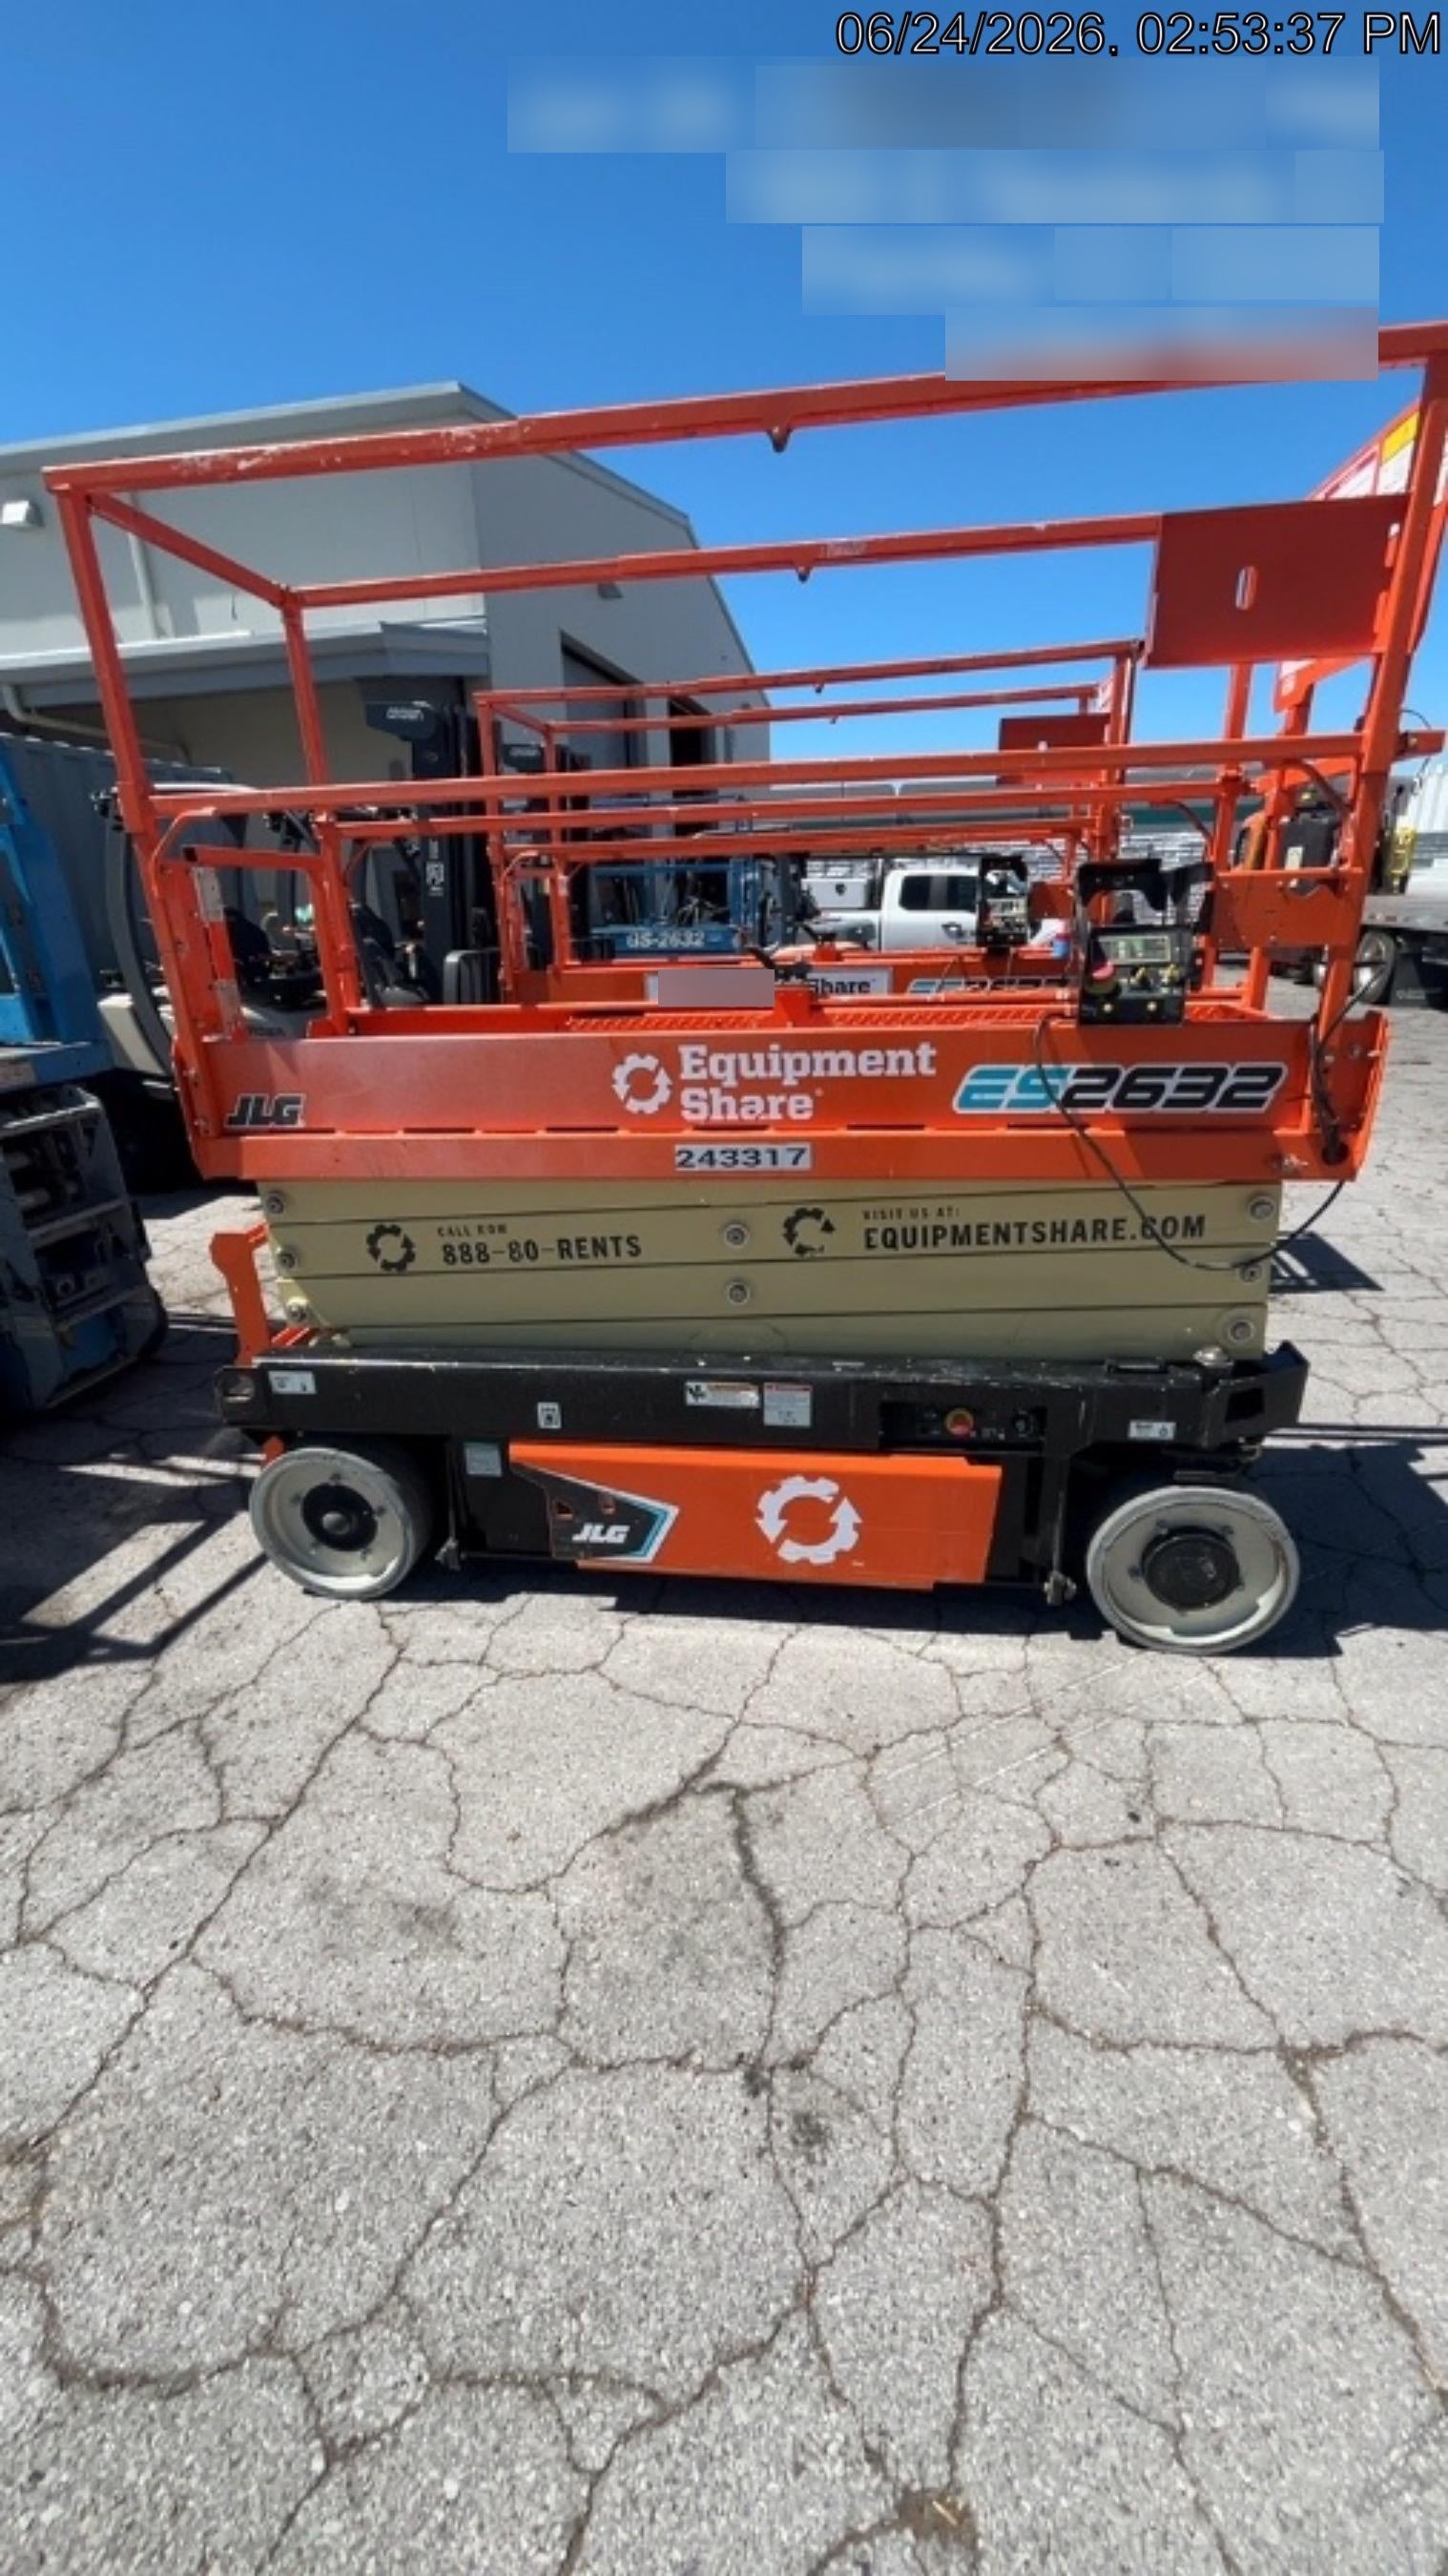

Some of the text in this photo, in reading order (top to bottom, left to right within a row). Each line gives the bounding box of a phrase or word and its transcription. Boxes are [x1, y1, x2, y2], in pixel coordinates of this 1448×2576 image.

[678, 1042, 937, 1086] Equipment
[680, 1088, 814, 1123] Share
[953, 1063, 1287, 1113] ES2632
[223, 1093, 306, 1129] JLG
[676, 1147, 807, 1169] 243317
[437, 1224, 471, 1237] CALL
[864, 1214, 1206, 1252] EQUIPMENTSHARE.COM
[442, 1235, 642, 1266] 888-80-RENTS
[572, 1523, 631, 1544] JLG
